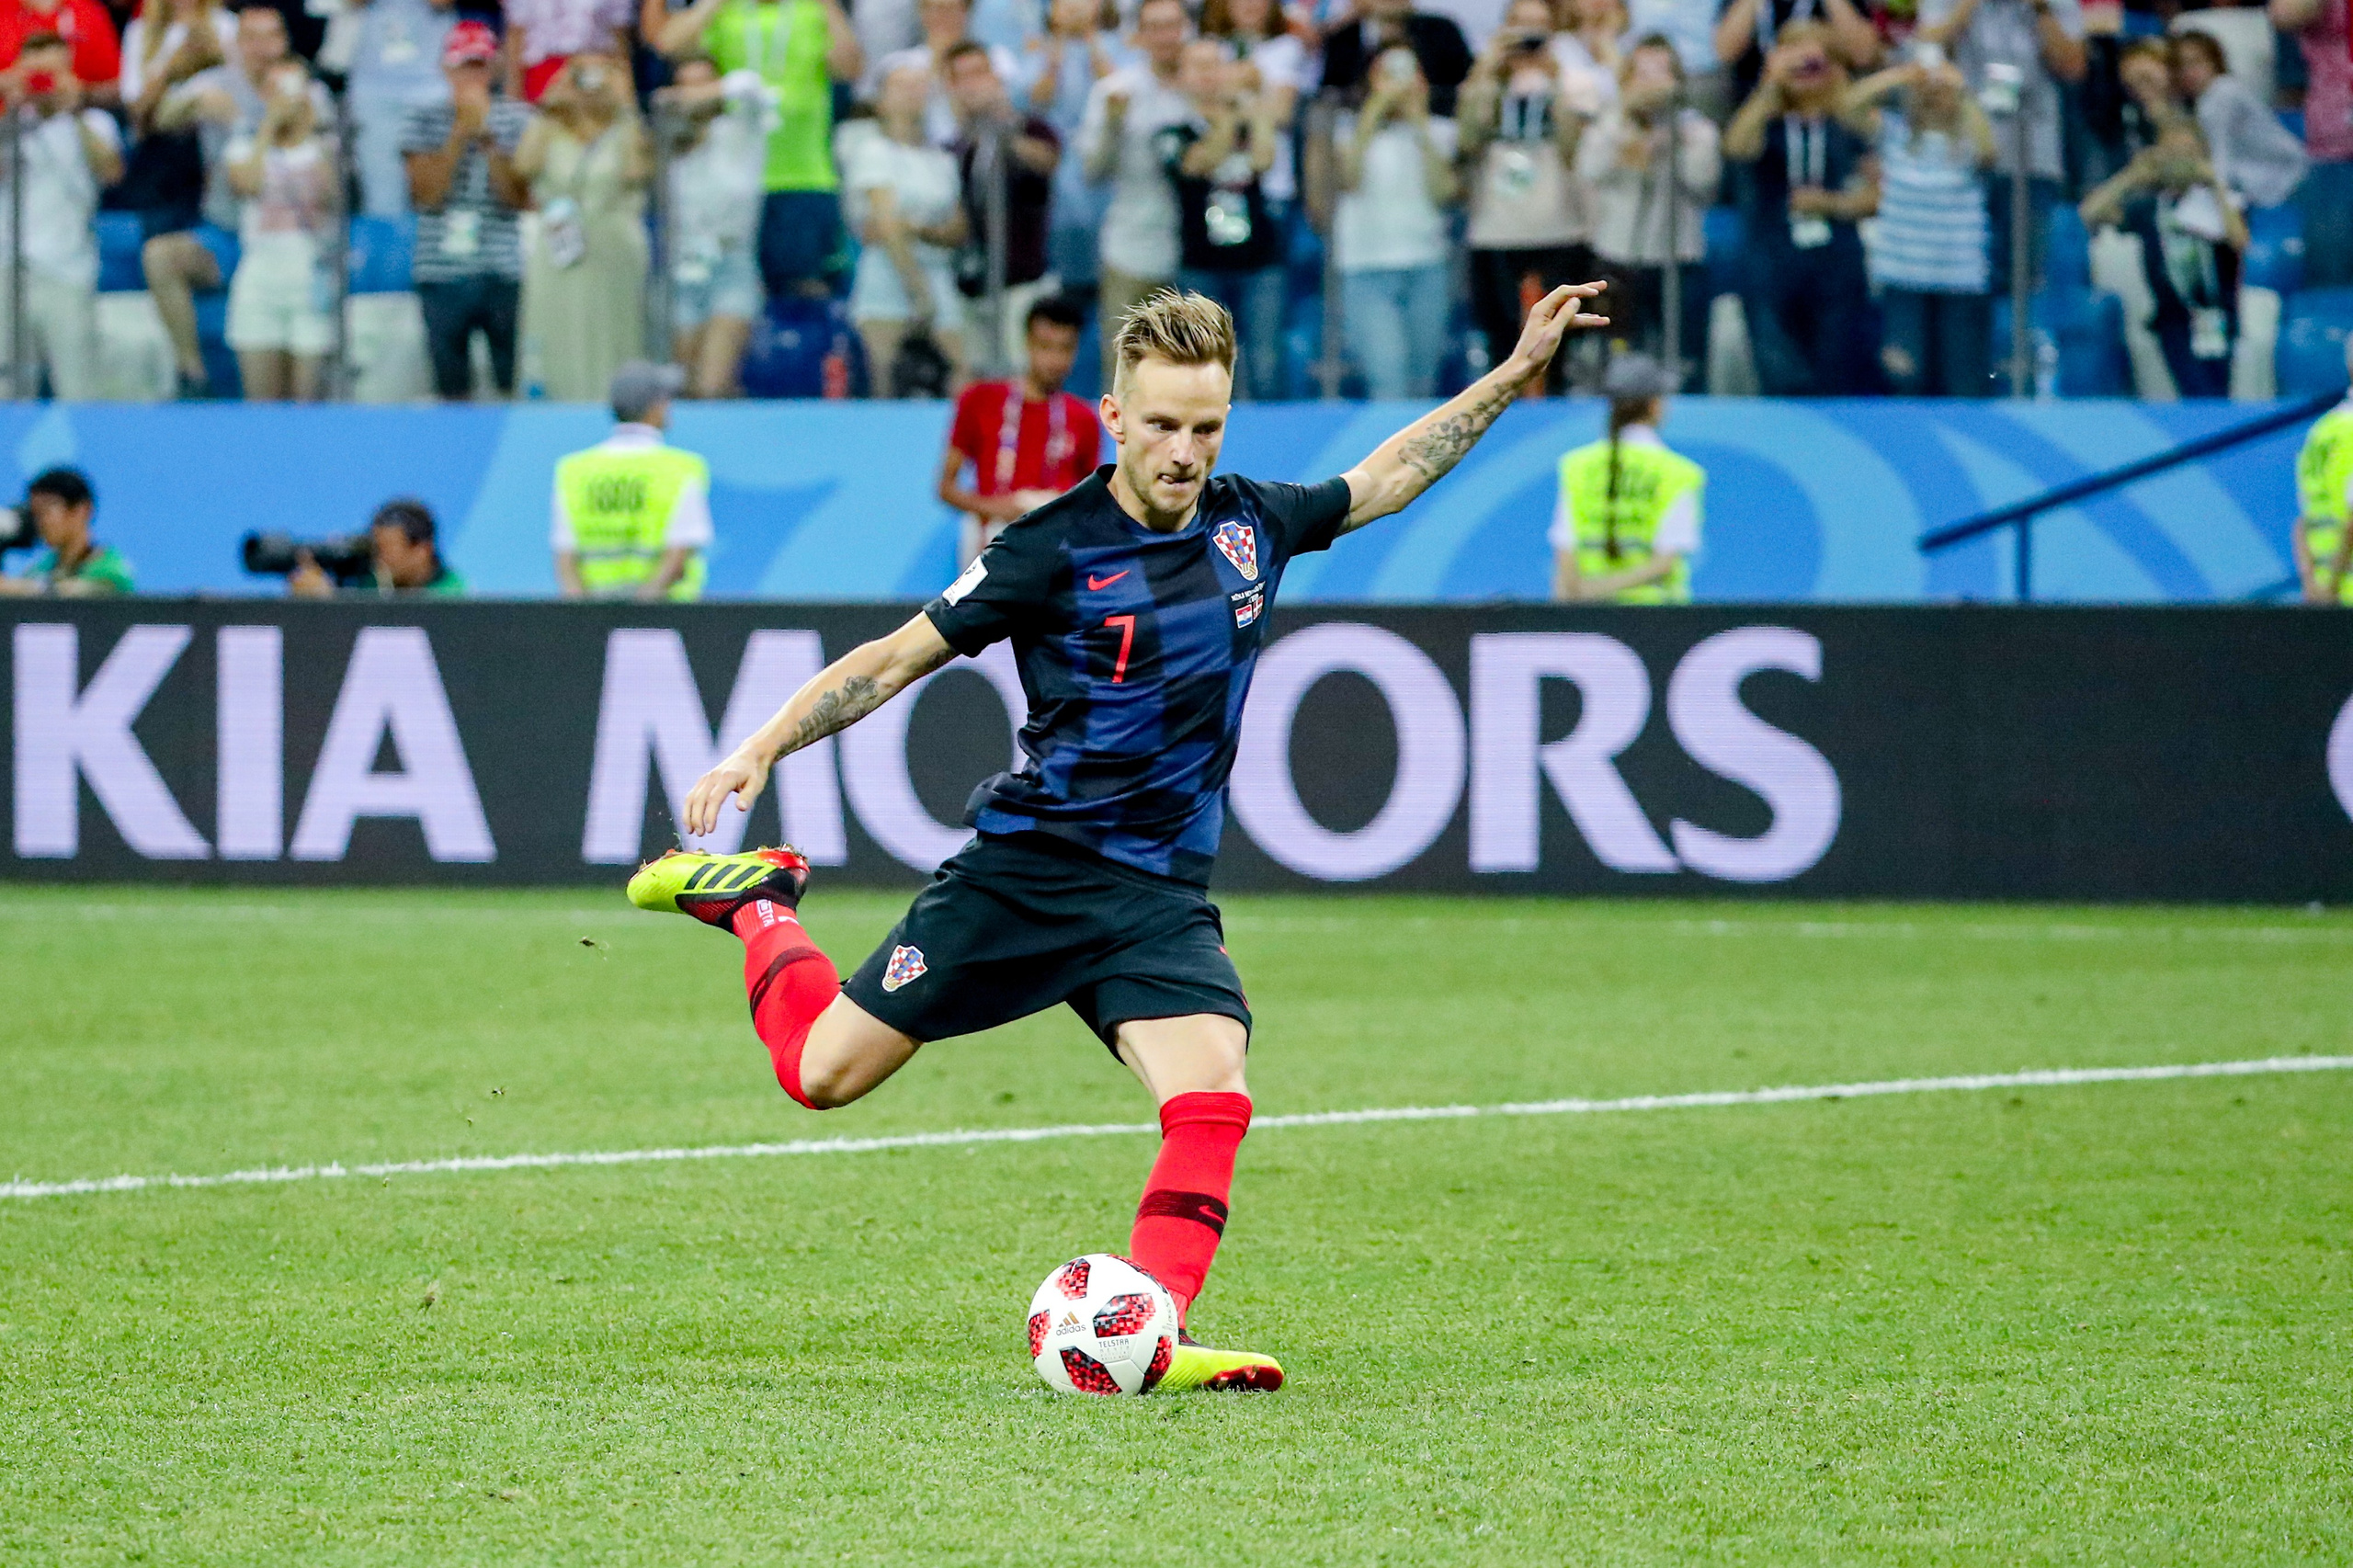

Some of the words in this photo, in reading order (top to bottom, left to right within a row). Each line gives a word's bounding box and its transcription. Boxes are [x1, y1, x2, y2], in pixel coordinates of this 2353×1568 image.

[1104, 615, 1136, 683] 7
[13, 622, 497, 863] KIA
[580, 622, 1842, 883] MOORS
[1055, 1324, 1086, 1335] adidas
